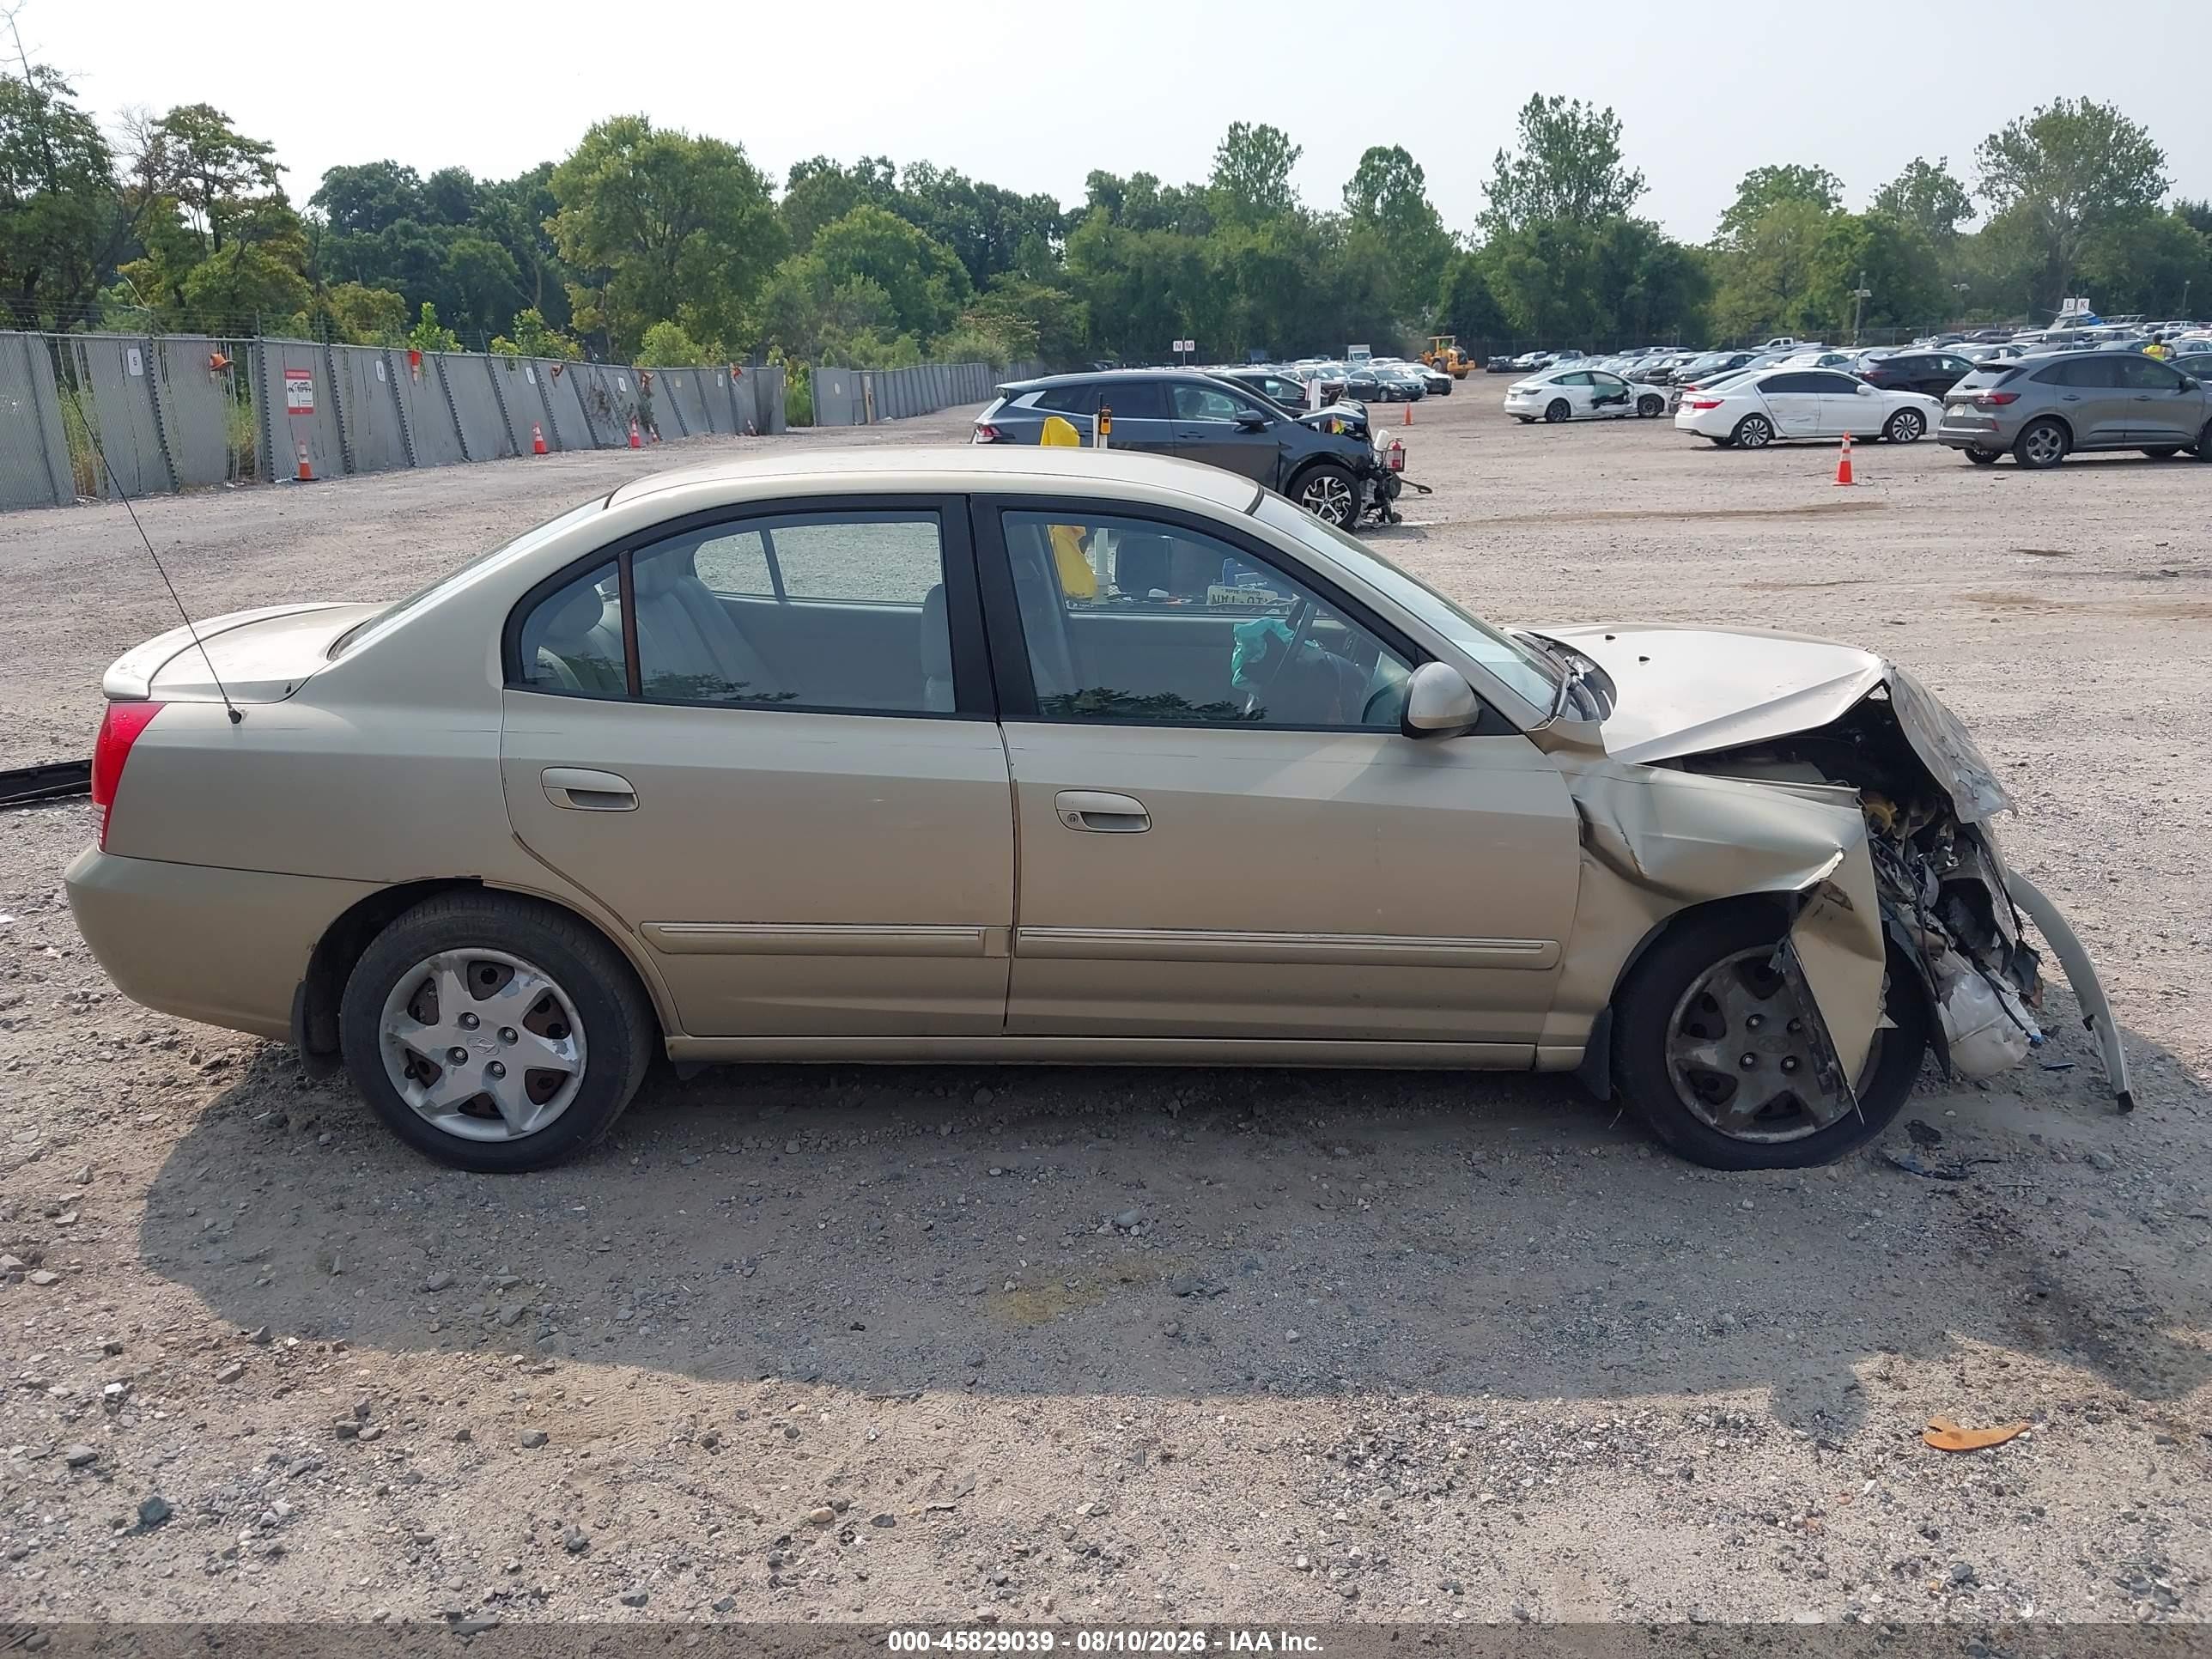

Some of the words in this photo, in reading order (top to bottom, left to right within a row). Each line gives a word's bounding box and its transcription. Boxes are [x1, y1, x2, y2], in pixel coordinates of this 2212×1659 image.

[2080, 300, 2087, 309] K
[1175, 342, 1182, 350] N
[132, 356, 138, 367] 5
